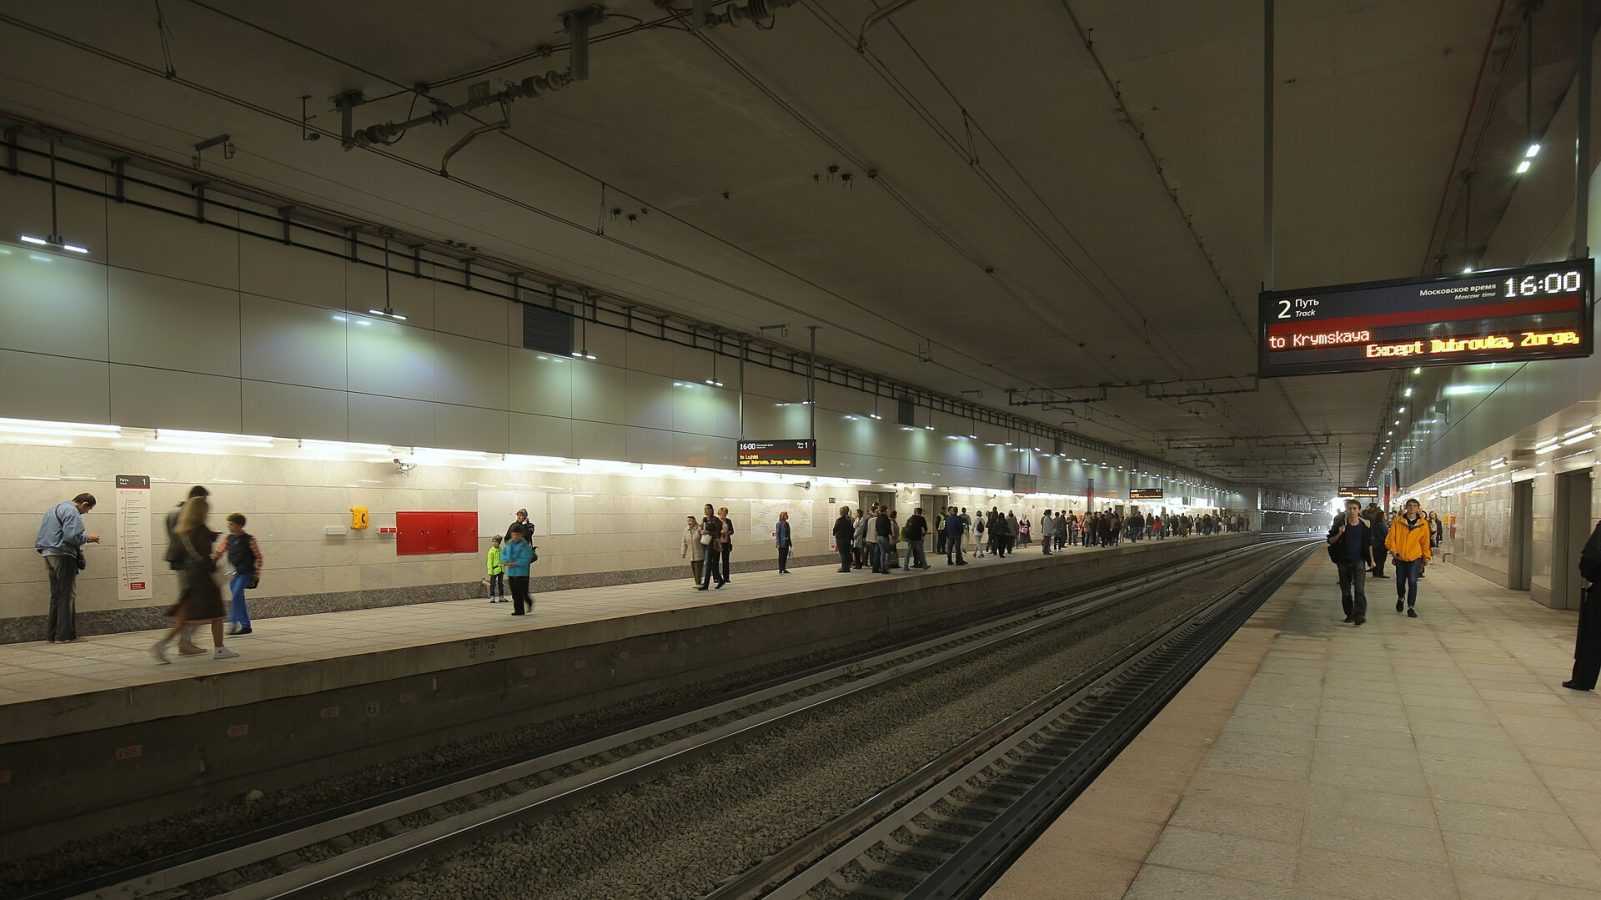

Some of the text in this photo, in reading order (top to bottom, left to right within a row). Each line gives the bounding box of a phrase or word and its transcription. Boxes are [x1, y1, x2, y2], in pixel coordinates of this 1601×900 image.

[1419, 283, 1497, 297] Московское время
[1505, 271, 1581, 298] 16:00
[1454, 290, 1497, 300] Moscow time
[1278, 298, 1320, 319] 2 Путь
[1296, 309, 1316, 318] Track
[1268, 329, 1371, 349] to Krymskaya
[1366, 340, 1424, 358] Except
